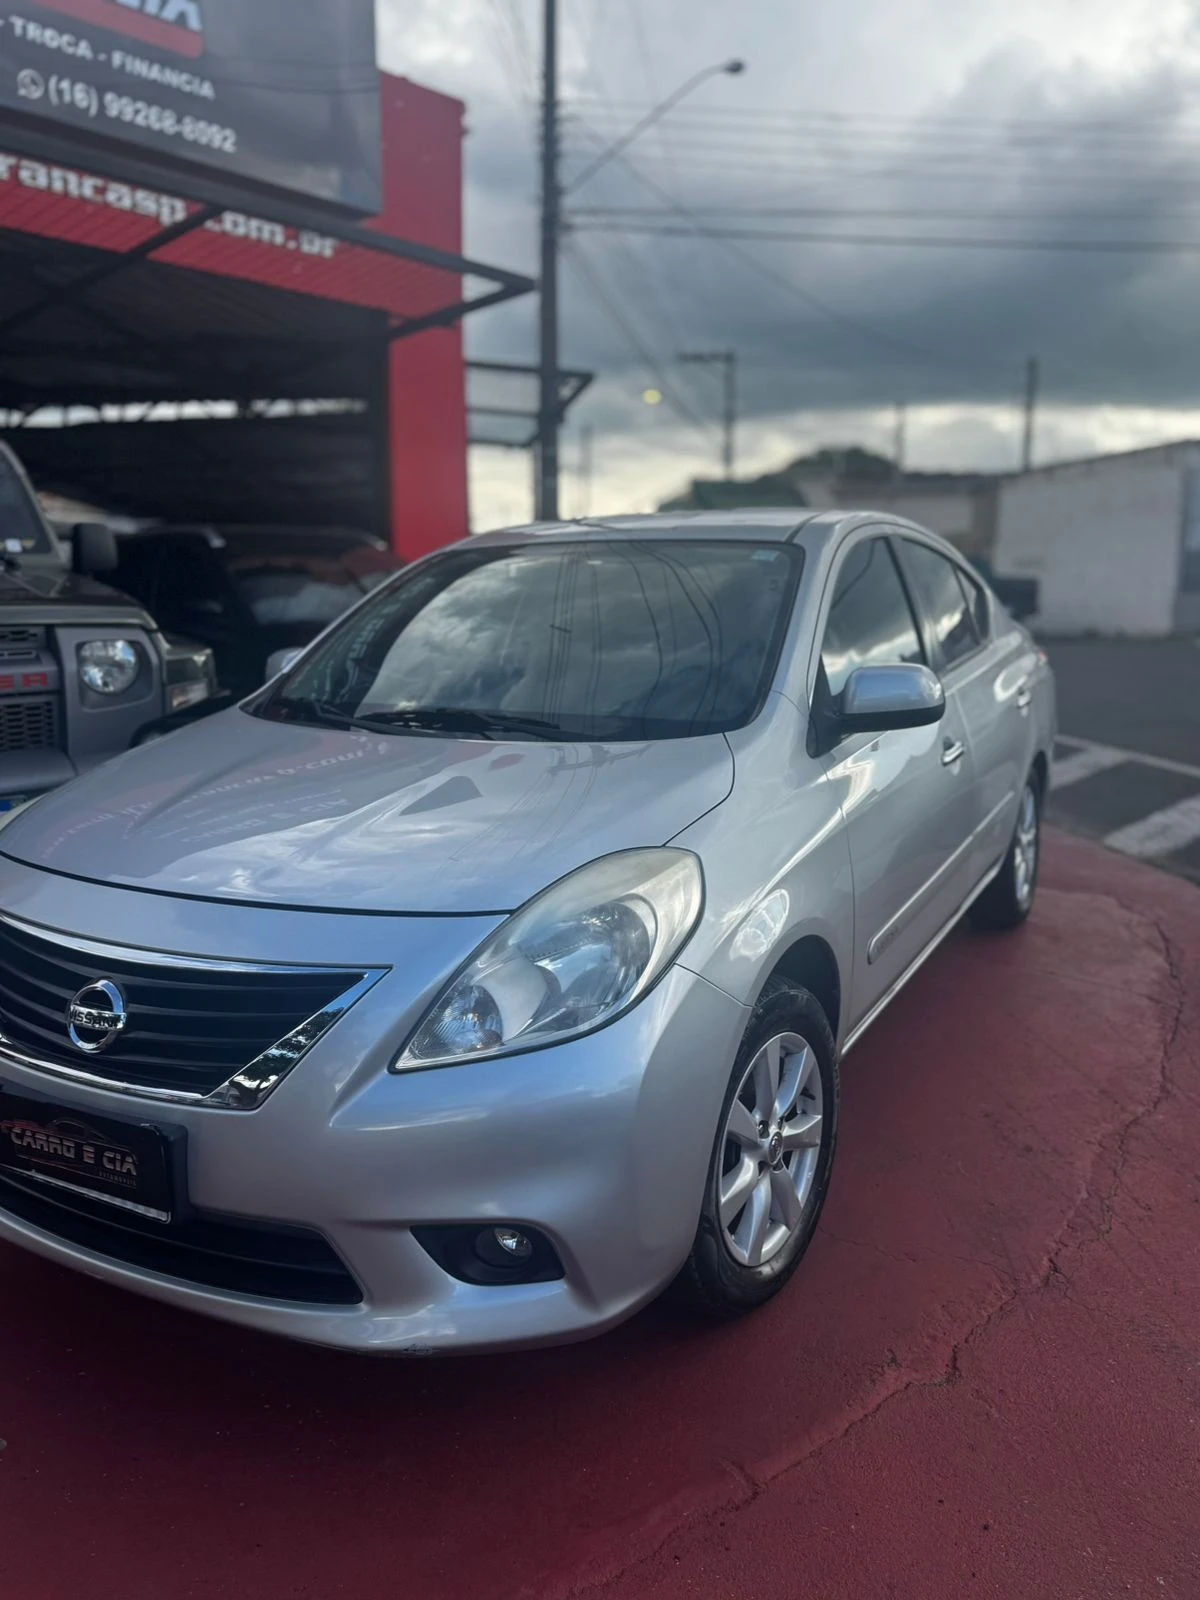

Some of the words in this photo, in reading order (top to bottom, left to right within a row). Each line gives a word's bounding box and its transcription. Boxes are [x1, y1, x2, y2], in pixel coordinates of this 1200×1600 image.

[9, 15, 94, 60] TROCA
[111, 50, 216, 100] FINANCIA
[48, 75, 99, 117] (16)
[69, 1008, 123, 1028] NISSAN
[10, 1127, 76, 1159] CARRO
[82, 1144, 95, 1164] E
[102, 1151, 137, 1176] CIA
